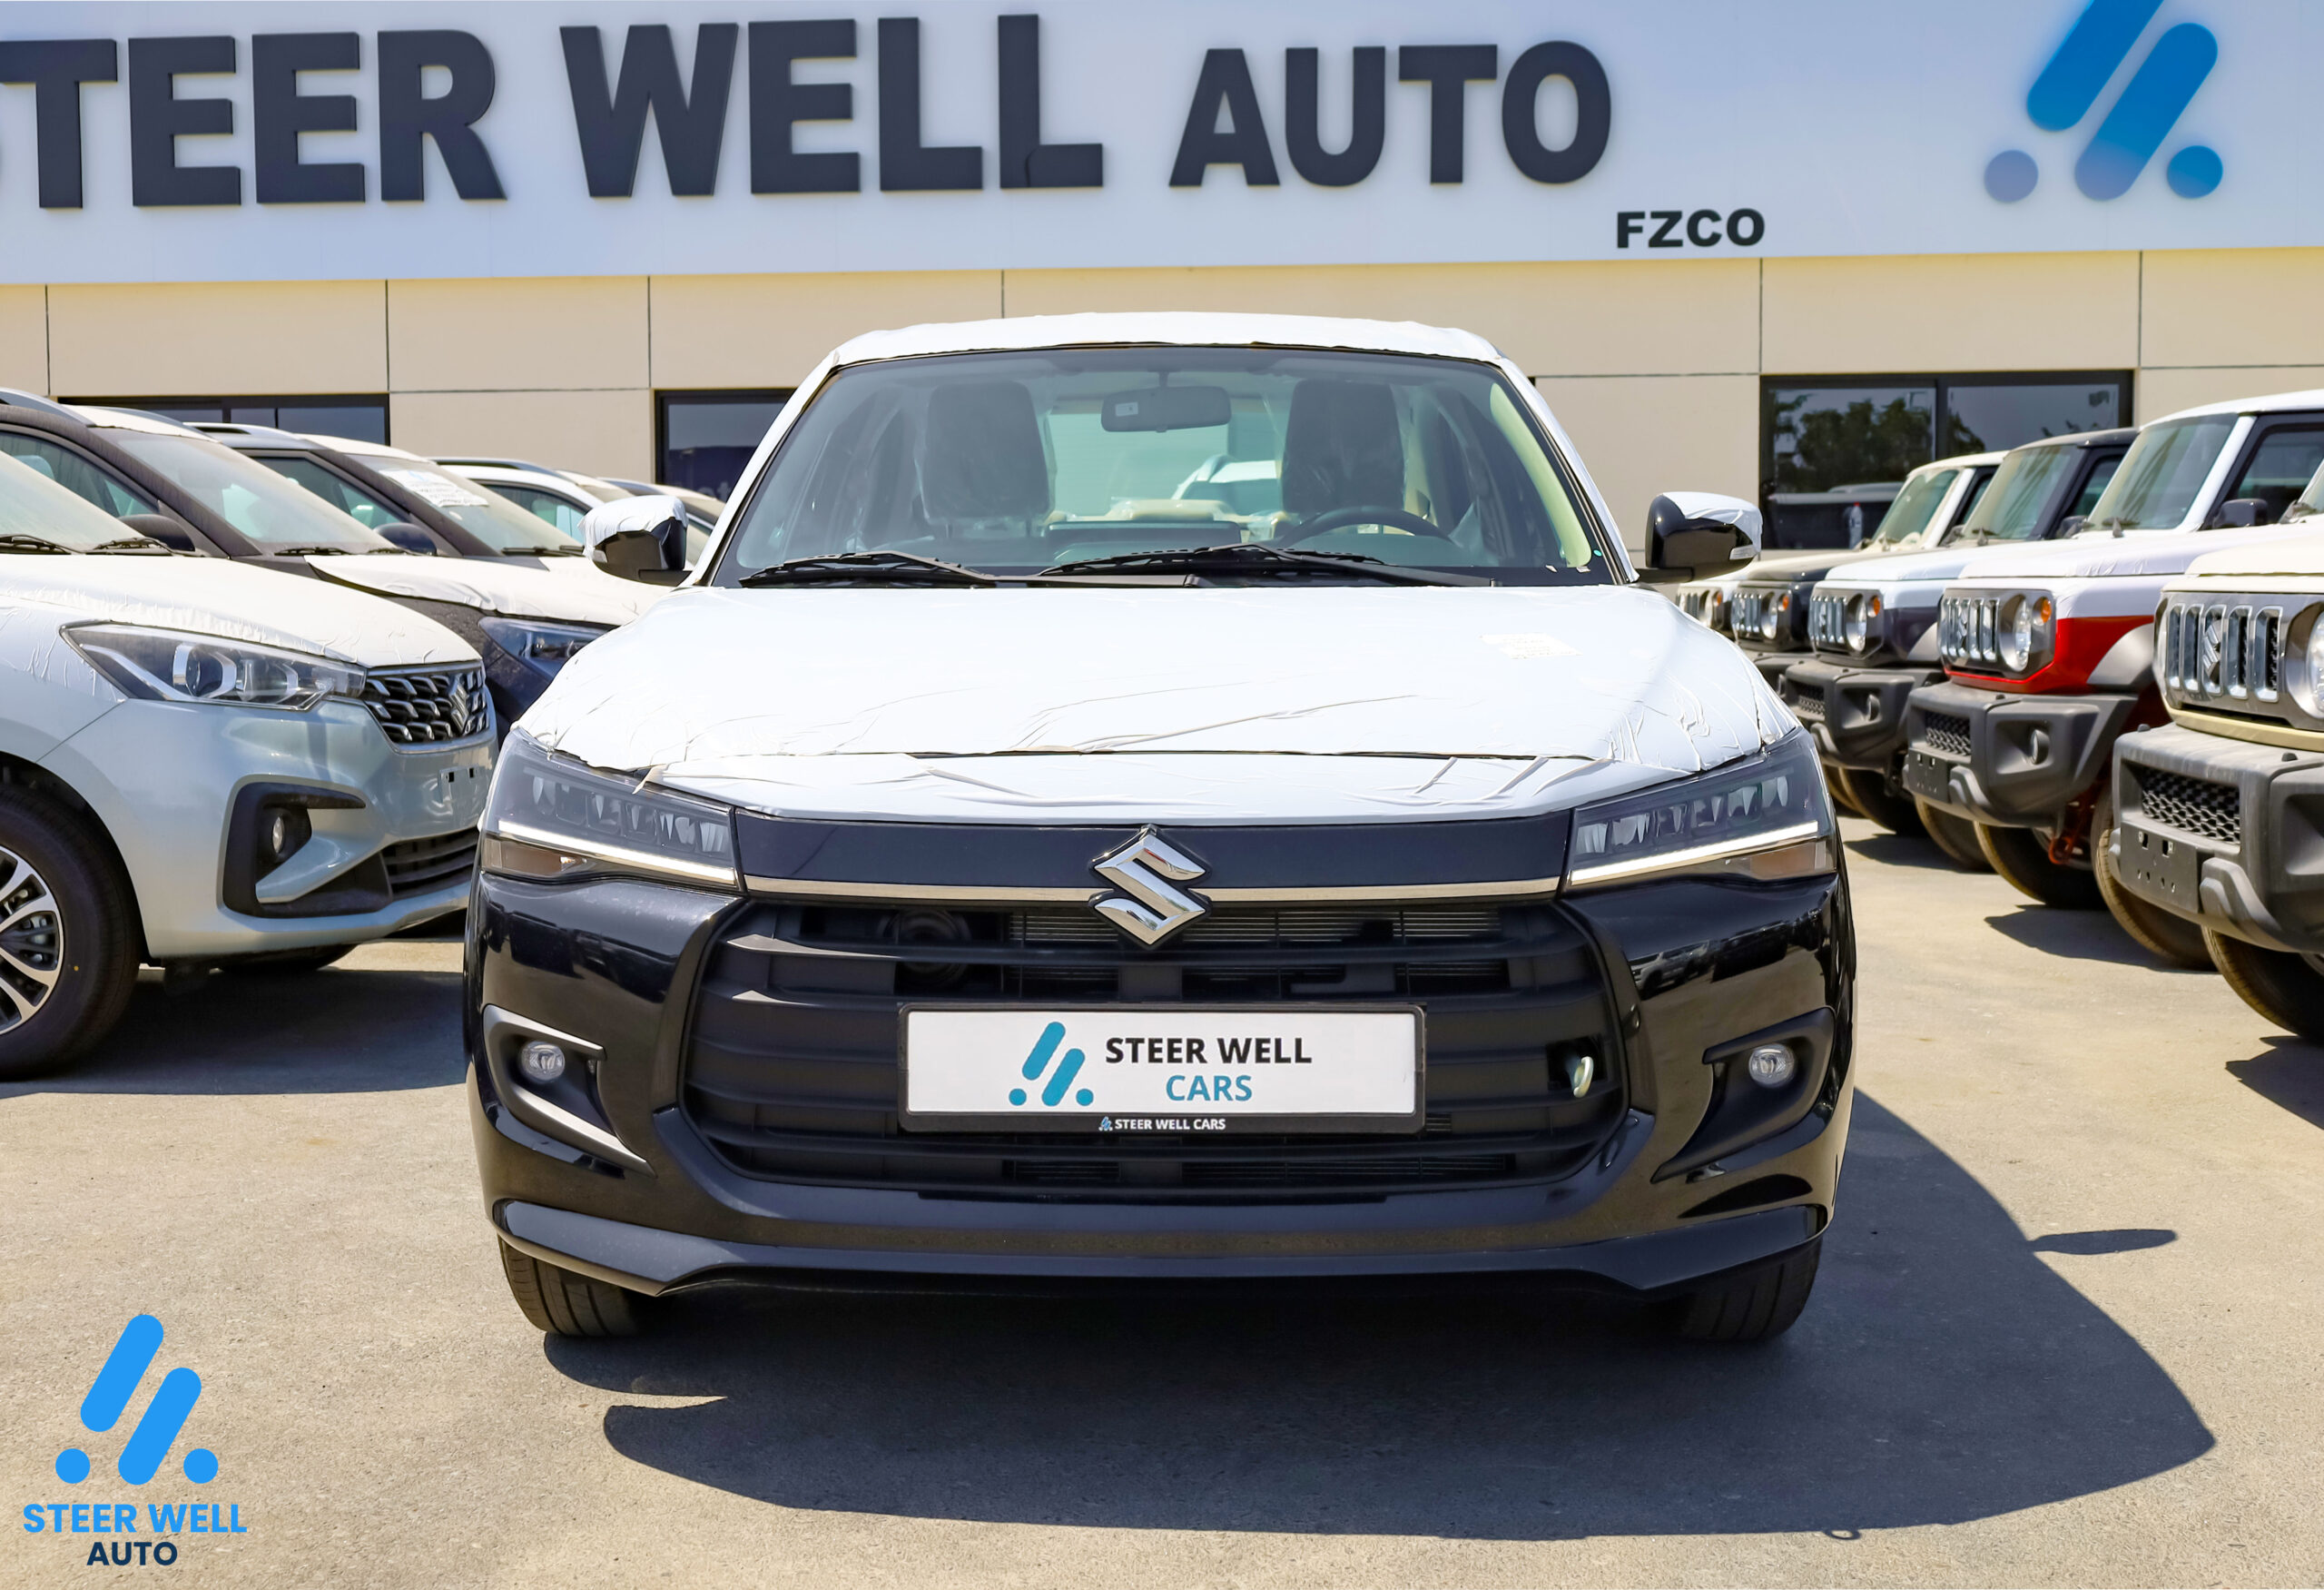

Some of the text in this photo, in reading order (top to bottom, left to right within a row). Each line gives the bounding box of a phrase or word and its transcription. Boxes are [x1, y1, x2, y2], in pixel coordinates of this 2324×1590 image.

[0, 14, 1612, 209] TEER WELL AUTO
[1617, 208, 1766, 249] FZCO
[1106, 1037, 1313, 1064] STEER WELL
[1166, 1074, 1254, 1102] CARS
[1114, 1118, 1226, 1131] STEER WELL CARS
